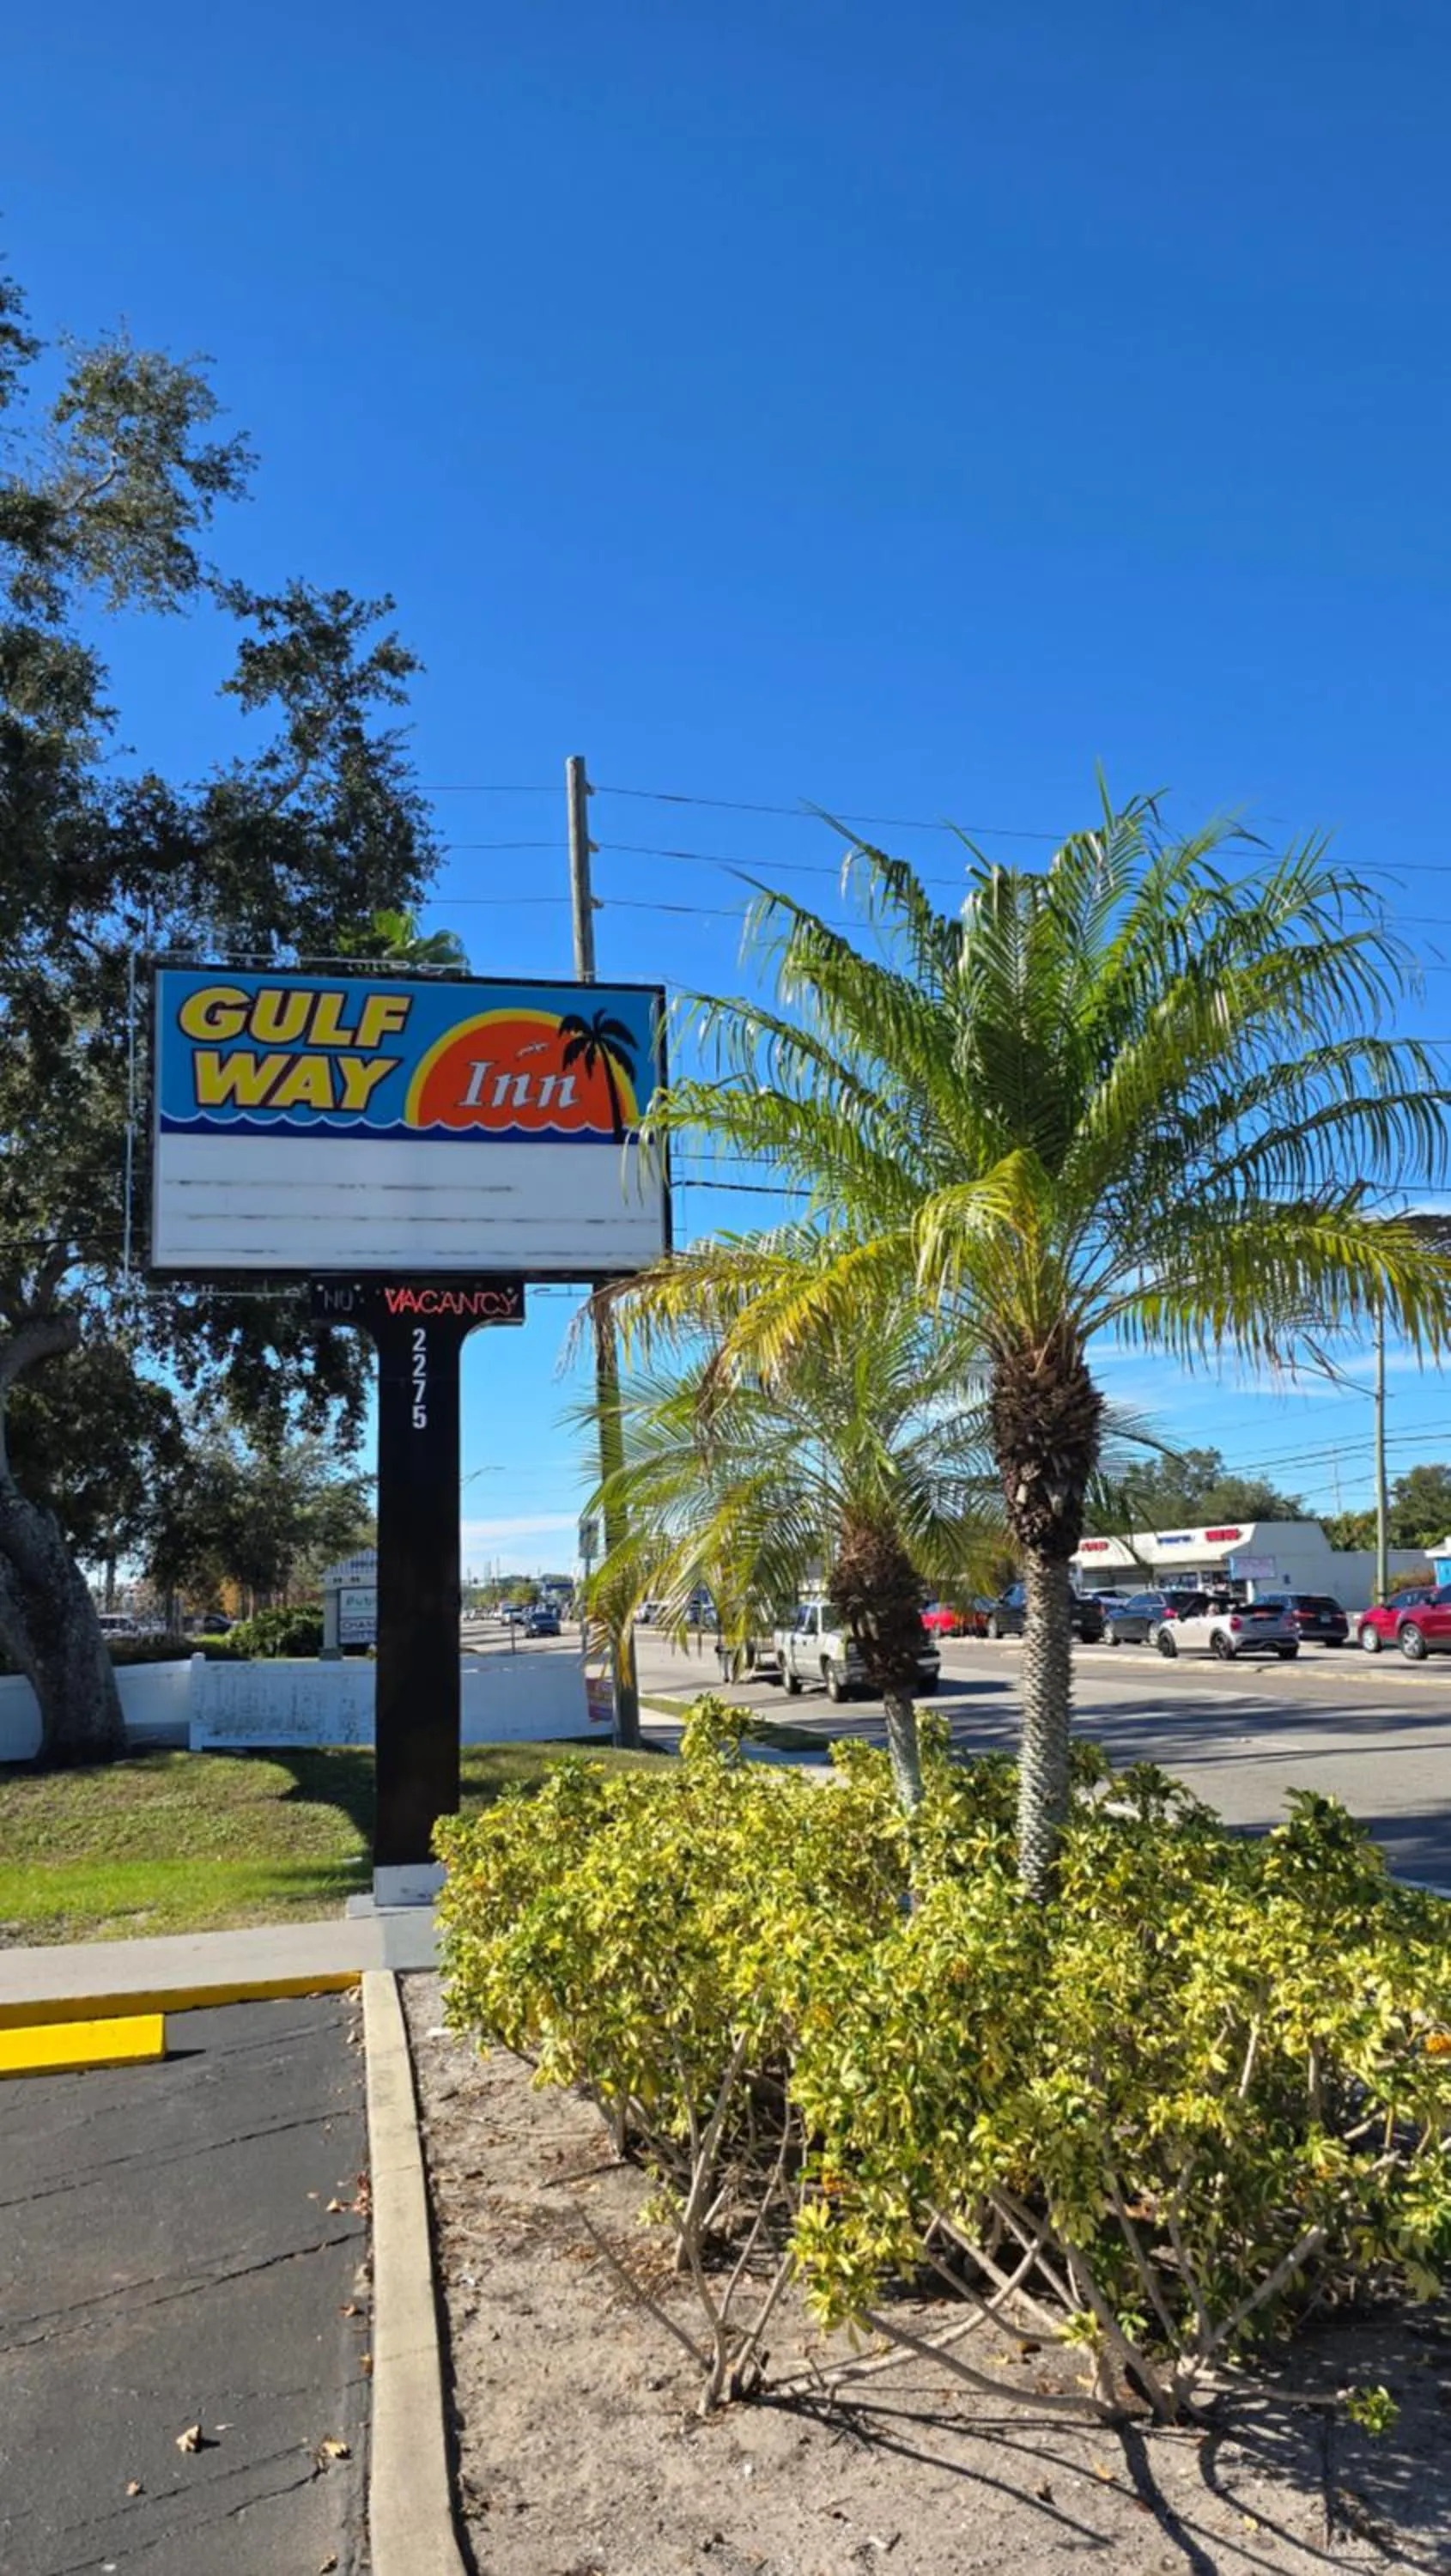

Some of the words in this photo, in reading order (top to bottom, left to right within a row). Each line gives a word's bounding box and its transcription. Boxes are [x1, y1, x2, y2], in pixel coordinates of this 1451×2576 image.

[179, 986, 412, 1048] GULF
[194, 1050, 402, 1111] WAY
[456, 1060, 580, 1109] Inn
[323, 1289, 355, 1311] NO
[385, 1288, 519, 1315] VACANCY
[411, 1328, 428, 1429] 2275
